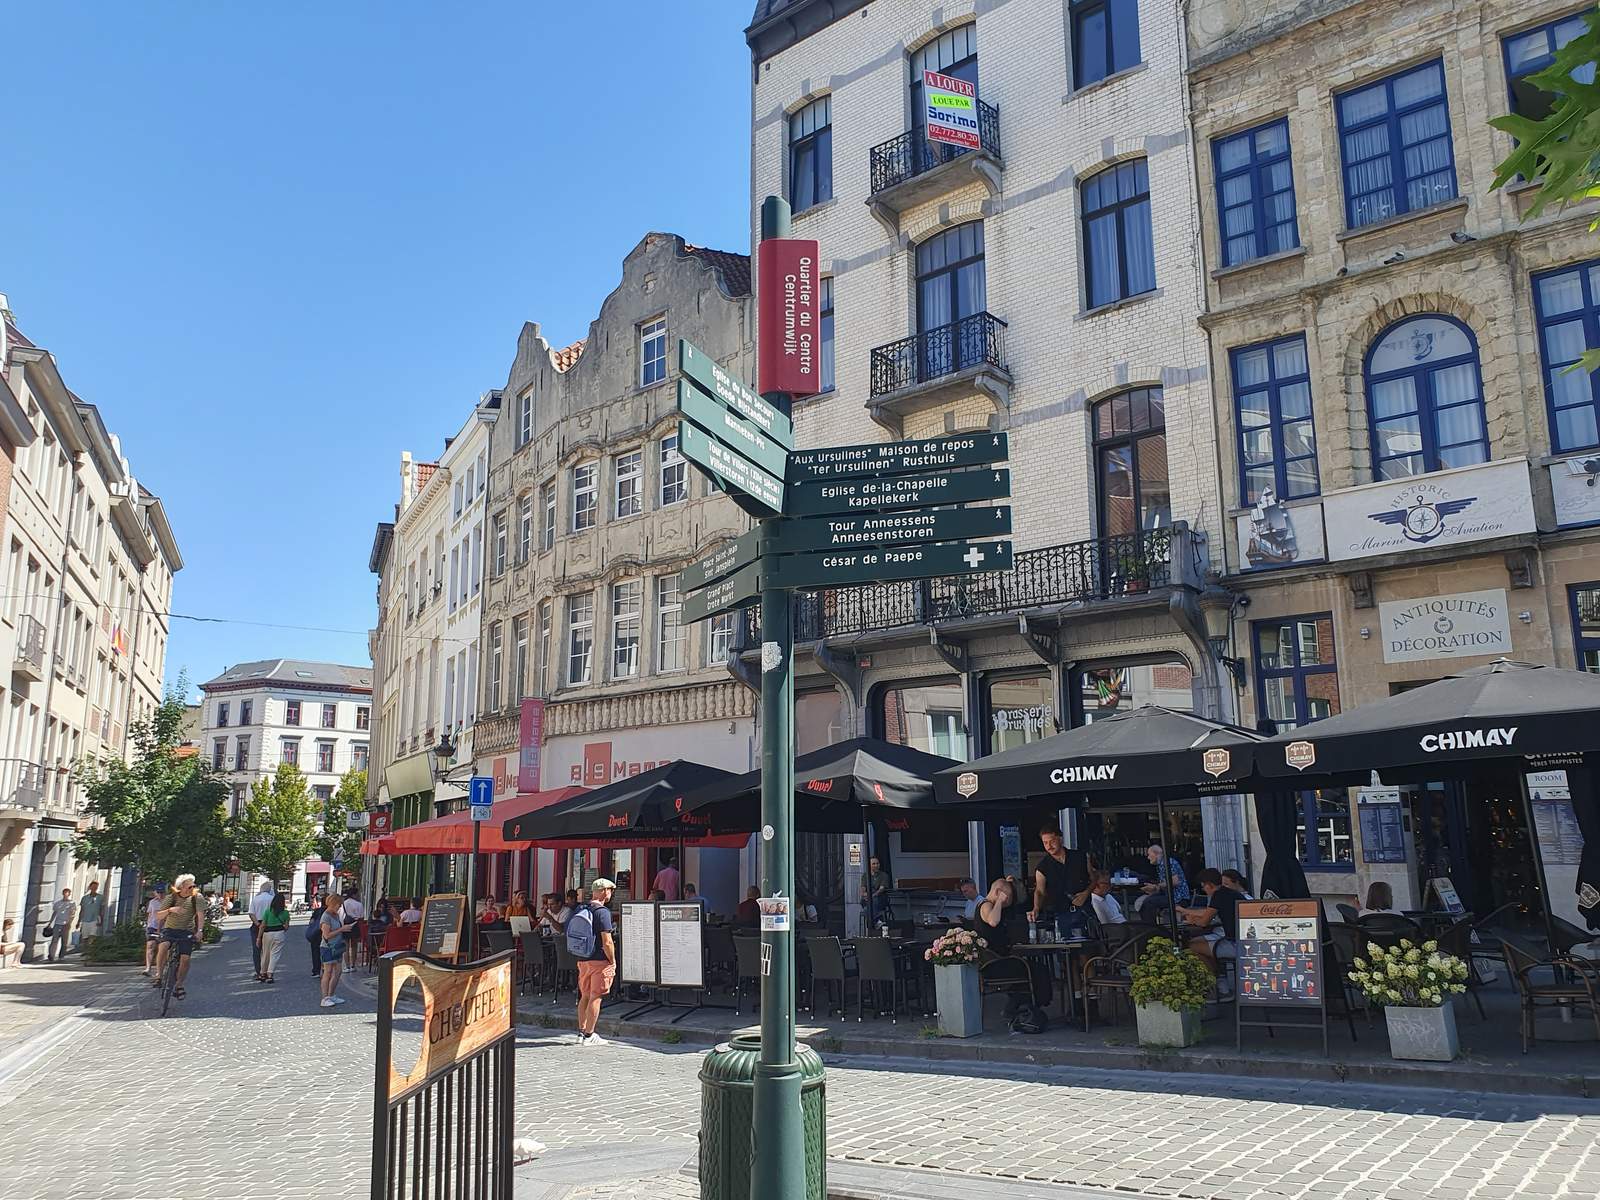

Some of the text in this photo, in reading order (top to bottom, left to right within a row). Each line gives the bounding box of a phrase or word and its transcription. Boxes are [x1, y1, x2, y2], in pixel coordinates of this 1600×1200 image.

[927, 74, 974, 96] A LOUER
[928, 106, 977, 129] Sorimo
[784, 274, 797, 355] Centrumwijk
[800, 257, 812, 374] Quartier du Centre
[724, 414, 765, 450] Manneken-Pis
[708, 440, 721, 458] Tour
[723, 451, 731, 465] de
[731, 456, 749, 475] Villers
[879, 444, 918, 457] Maison
[923, 441, 937, 454] de
[942, 438, 975, 453] repos
[902, 453, 955, 468] Rusthuis
[821, 477, 948, 499] Eglise de-la-Chapelle
[1390, 483, 1452, 509] HISTORIC
[848, 491, 919, 508] Kapellekerk
[829, 514, 936, 533] Tour Anneessens
[831, 526, 934, 544] Anneesenstoren
[1350, 520, 1505, 551] Marine Aviation
[703, 557, 714, 569] Place
[823, 550, 923, 568] César de Paepe
[707, 591, 734, 610] Grote Markt
[1392, 599, 1497, 630] ANTIQUITÉS
[1391, 630, 1503, 653] DÉCORATION
[1419, 727, 1518, 753] CHIMAY
[1049, 764, 1119, 784] CHIMAY
[1535, 774, 1564, 783] ROOM
[608, 811, 629, 828] Duvel
[428, 987, 496, 1044] CHOUFFE
